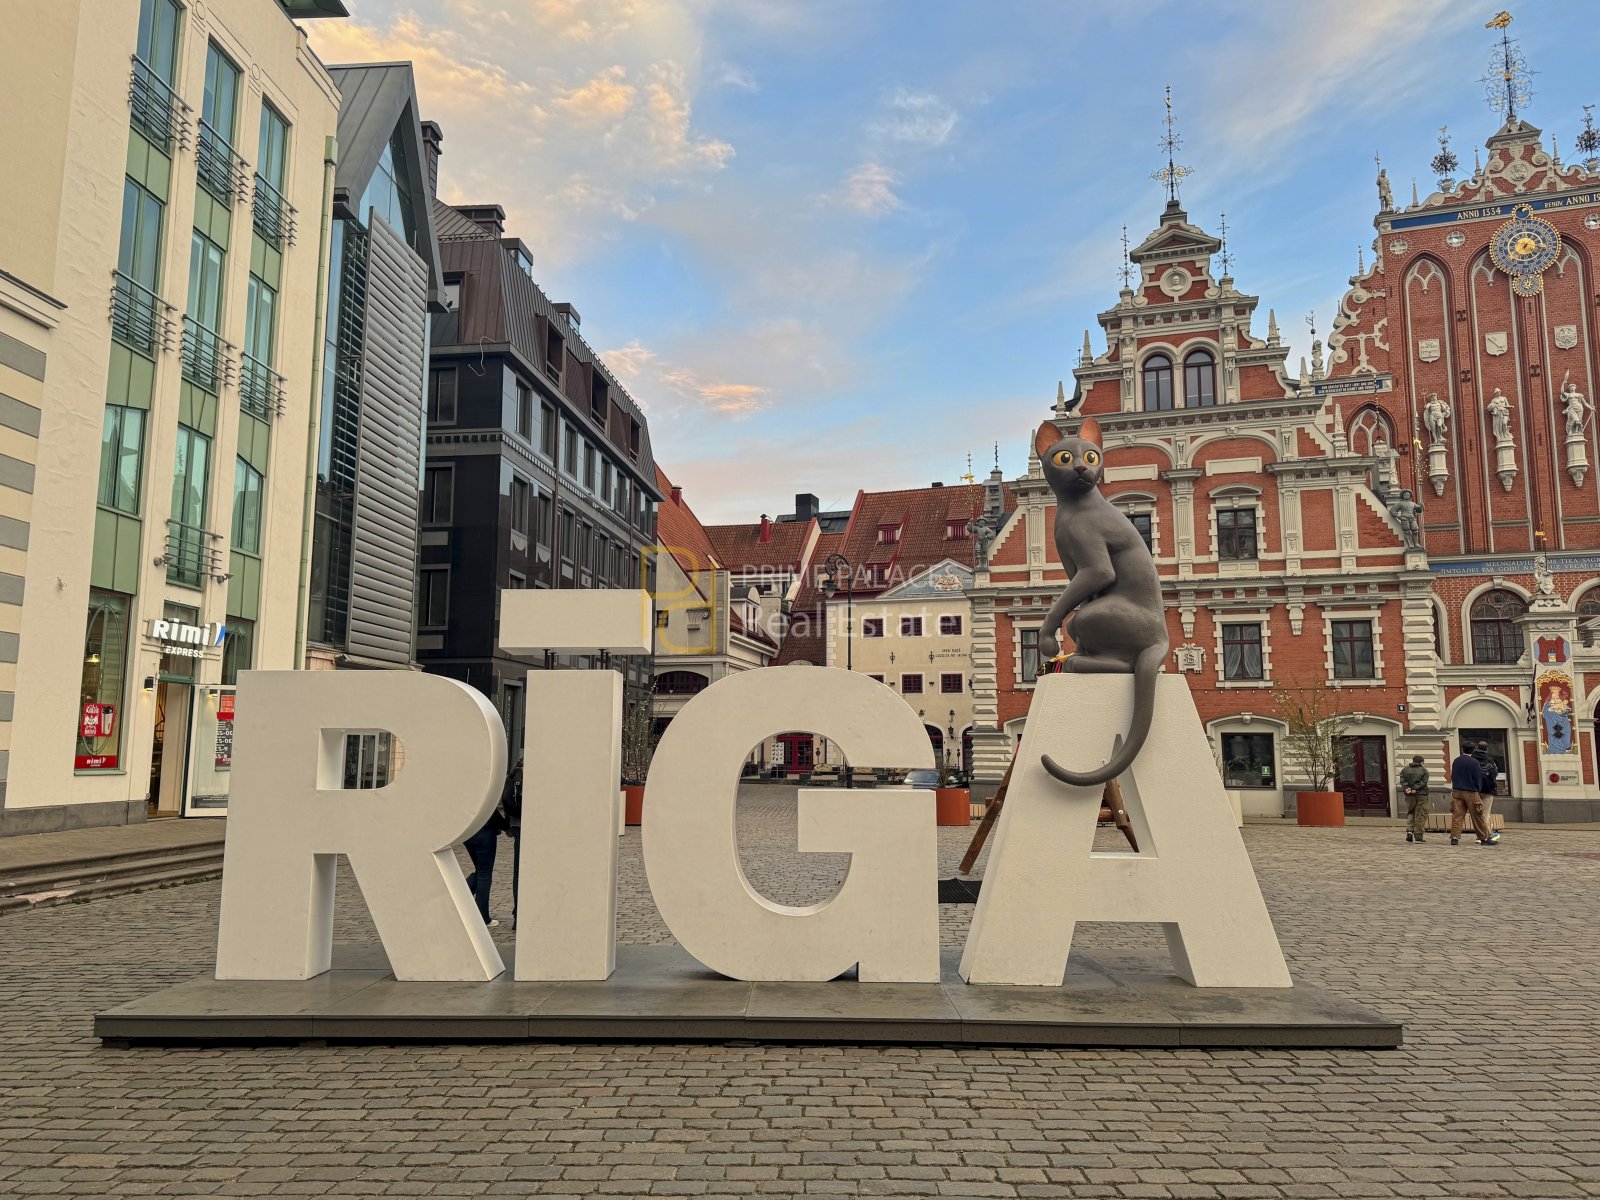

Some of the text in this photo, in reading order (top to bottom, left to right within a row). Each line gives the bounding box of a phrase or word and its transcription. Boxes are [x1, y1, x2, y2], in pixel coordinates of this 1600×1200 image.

[1565, 194, 1590, 206] ANNO
[1457, 206, 1501, 220] ANNO 1334
[152, 617, 211, 646] Rimi
[165, 645, 205, 658] EXPRESS
